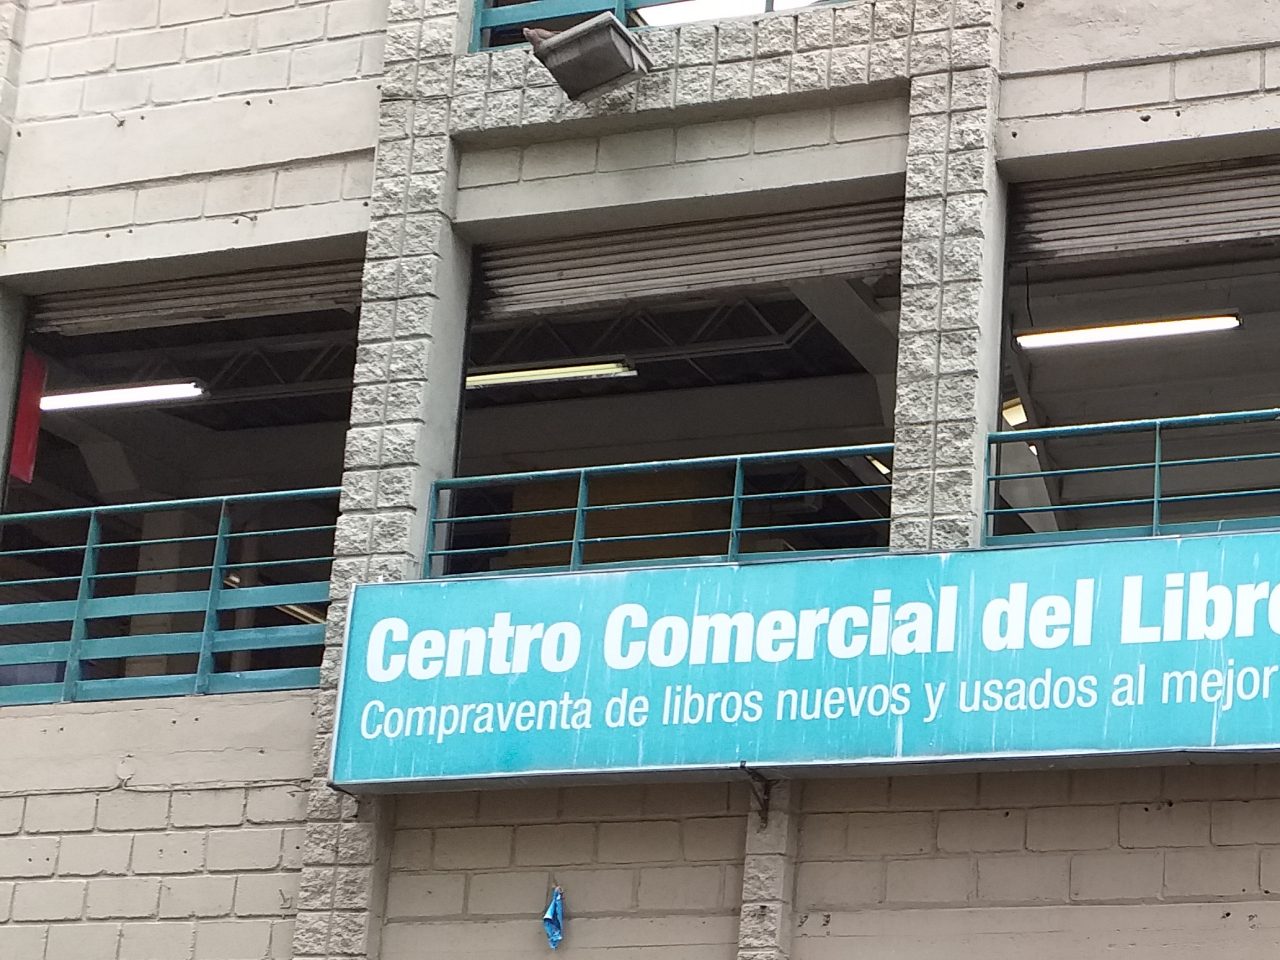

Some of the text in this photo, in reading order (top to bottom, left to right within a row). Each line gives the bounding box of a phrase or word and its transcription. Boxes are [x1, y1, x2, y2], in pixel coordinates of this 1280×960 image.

[366, 611, 581, 683] Centro
[603, 586, 957, 670] Comercial
[982, 578, 1095, 652] del
[360, 697, 592, 744] Compraventa
[605, 688, 649, 728] de
[662, 684, 763, 726] libros
[776, 681, 911, 722] nuevos
[923, 682, 946, 723] y
[959, 668, 1098, 713] usados
[1111, 664, 1146, 707] al
[1162, 658, 1279, 711] mejor
